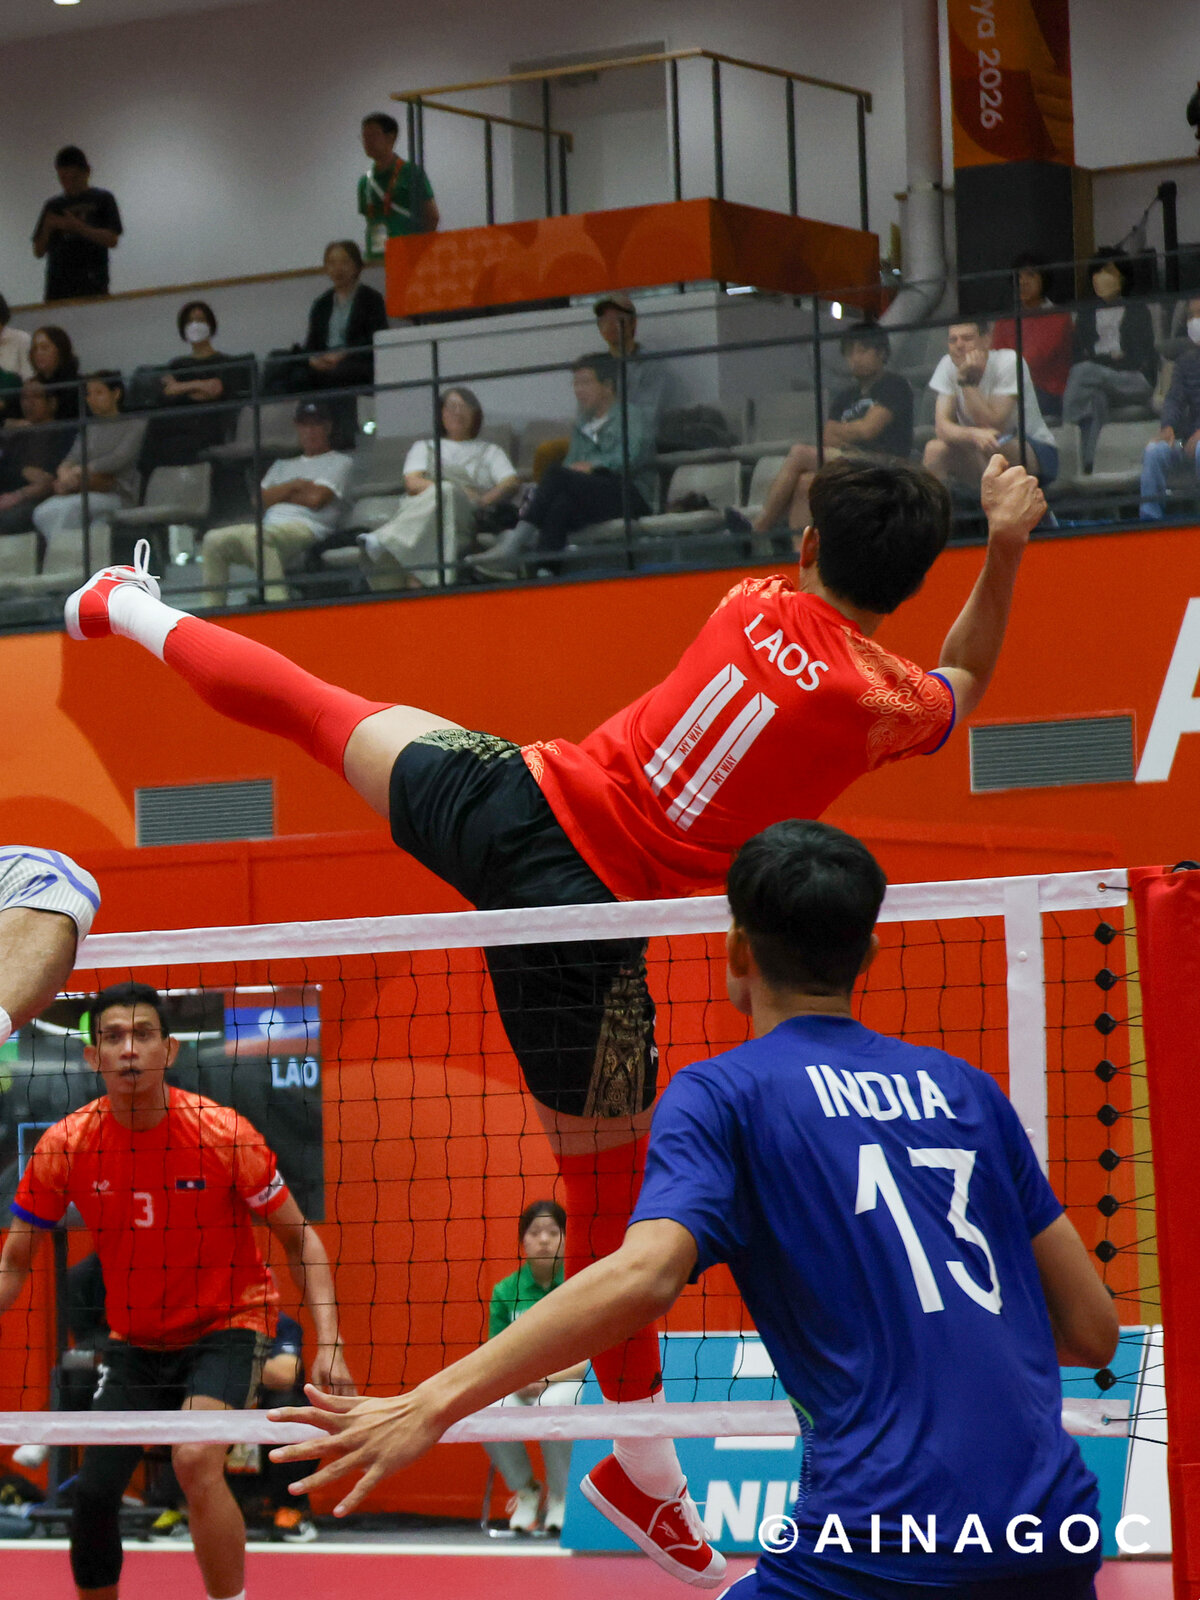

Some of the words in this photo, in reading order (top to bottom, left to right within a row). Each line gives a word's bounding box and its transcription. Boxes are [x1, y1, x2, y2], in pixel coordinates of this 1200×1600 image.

[978, 48, 1003, 129] 2026
[744, 613, 830, 692] LAOS
[644, 663, 780, 831] 11
[679, 740, 692, 756] MY
[687, 723, 704, 743] WAY
[711, 770, 725, 786] MY
[720, 754, 738, 773] WAY
[270, 1056, 319, 1088] LAO
[805, 1064, 958, 1121] INDIA
[132, 1191, 155, 1228] 3
[855, 1143, 1003, 1315] 13
[703, 1480, 800, 1542] NI
